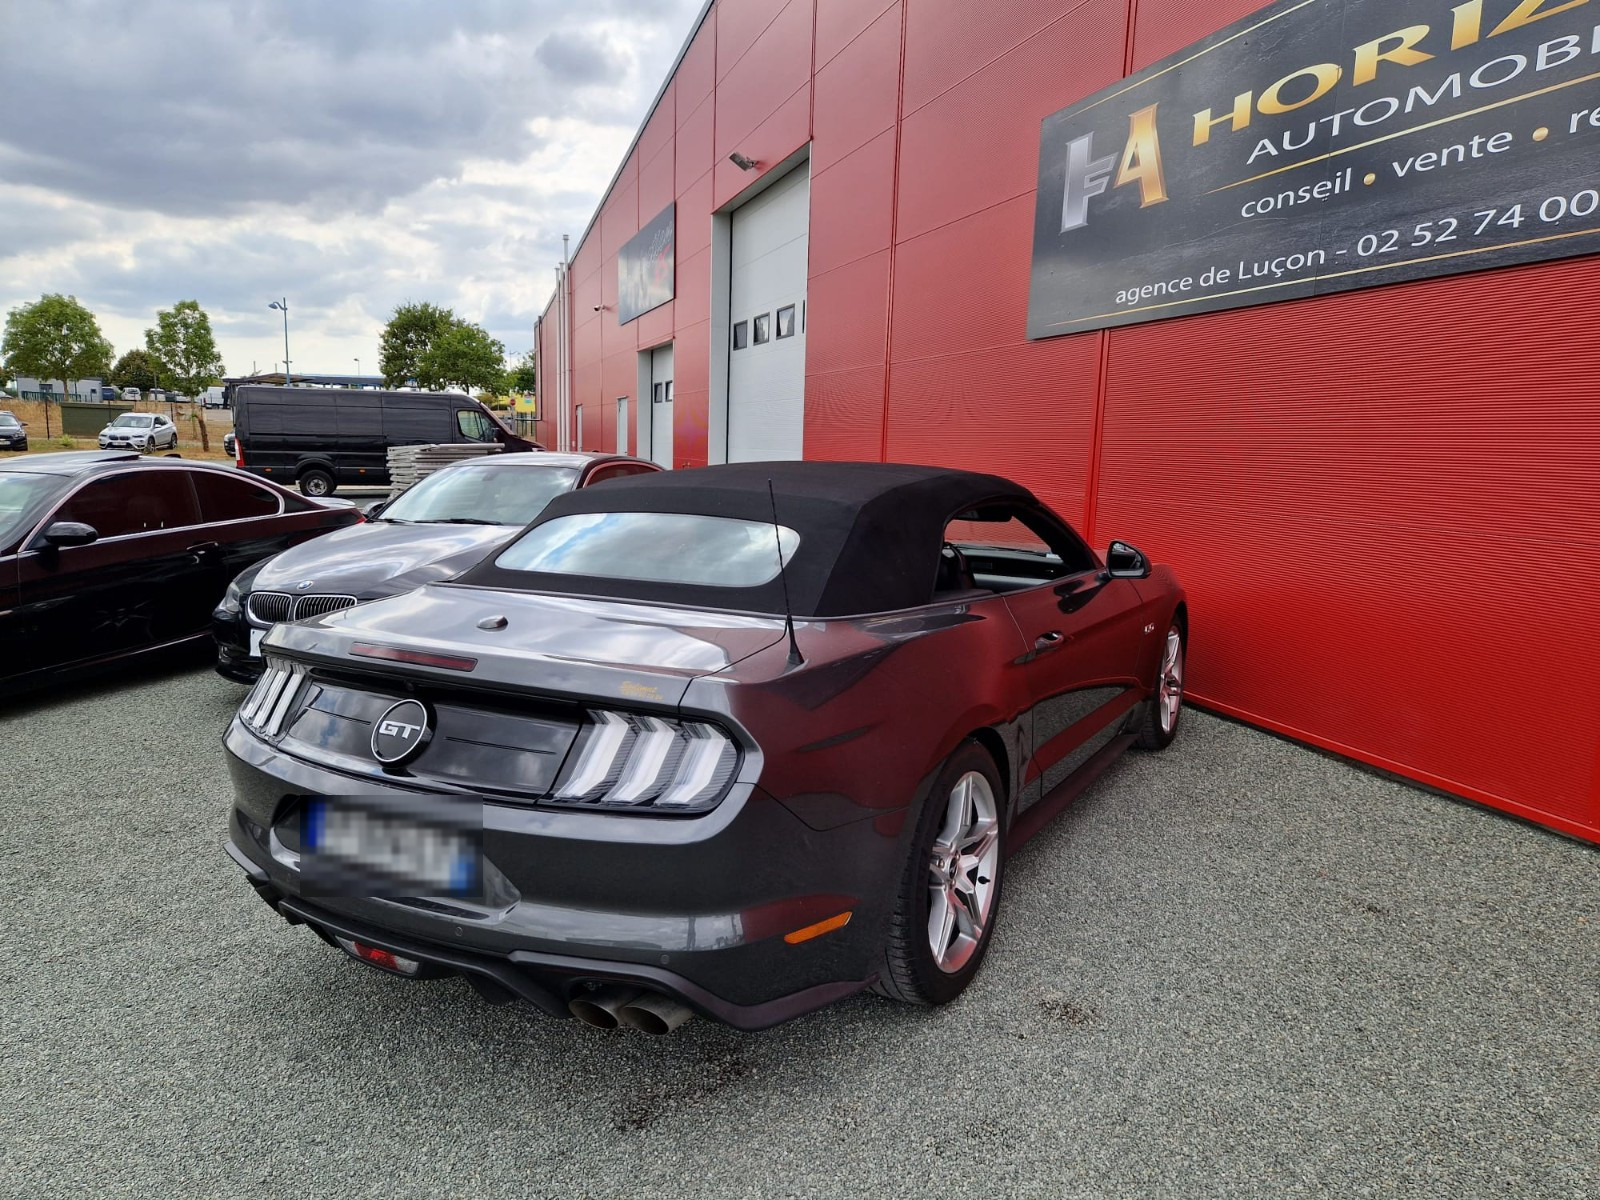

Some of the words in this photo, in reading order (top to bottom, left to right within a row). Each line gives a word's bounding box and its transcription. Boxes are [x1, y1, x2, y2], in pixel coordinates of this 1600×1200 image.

[1241, 167, 1352, 218] conseil
[1392, 131, 1513, 178] vente
[1115, 276, 1193, 305] agence
[1199, 266, 1231, 287] de
[1238, 249, 1325, 278] Luçon
[1357, 229, 1399, 256] 02
[1411, 217, 1458, 247] 52
[1473, 204, 1525, 235] 74
[1538, 189, 1599, 222] 00
[379, 720, 421, 739] GT
